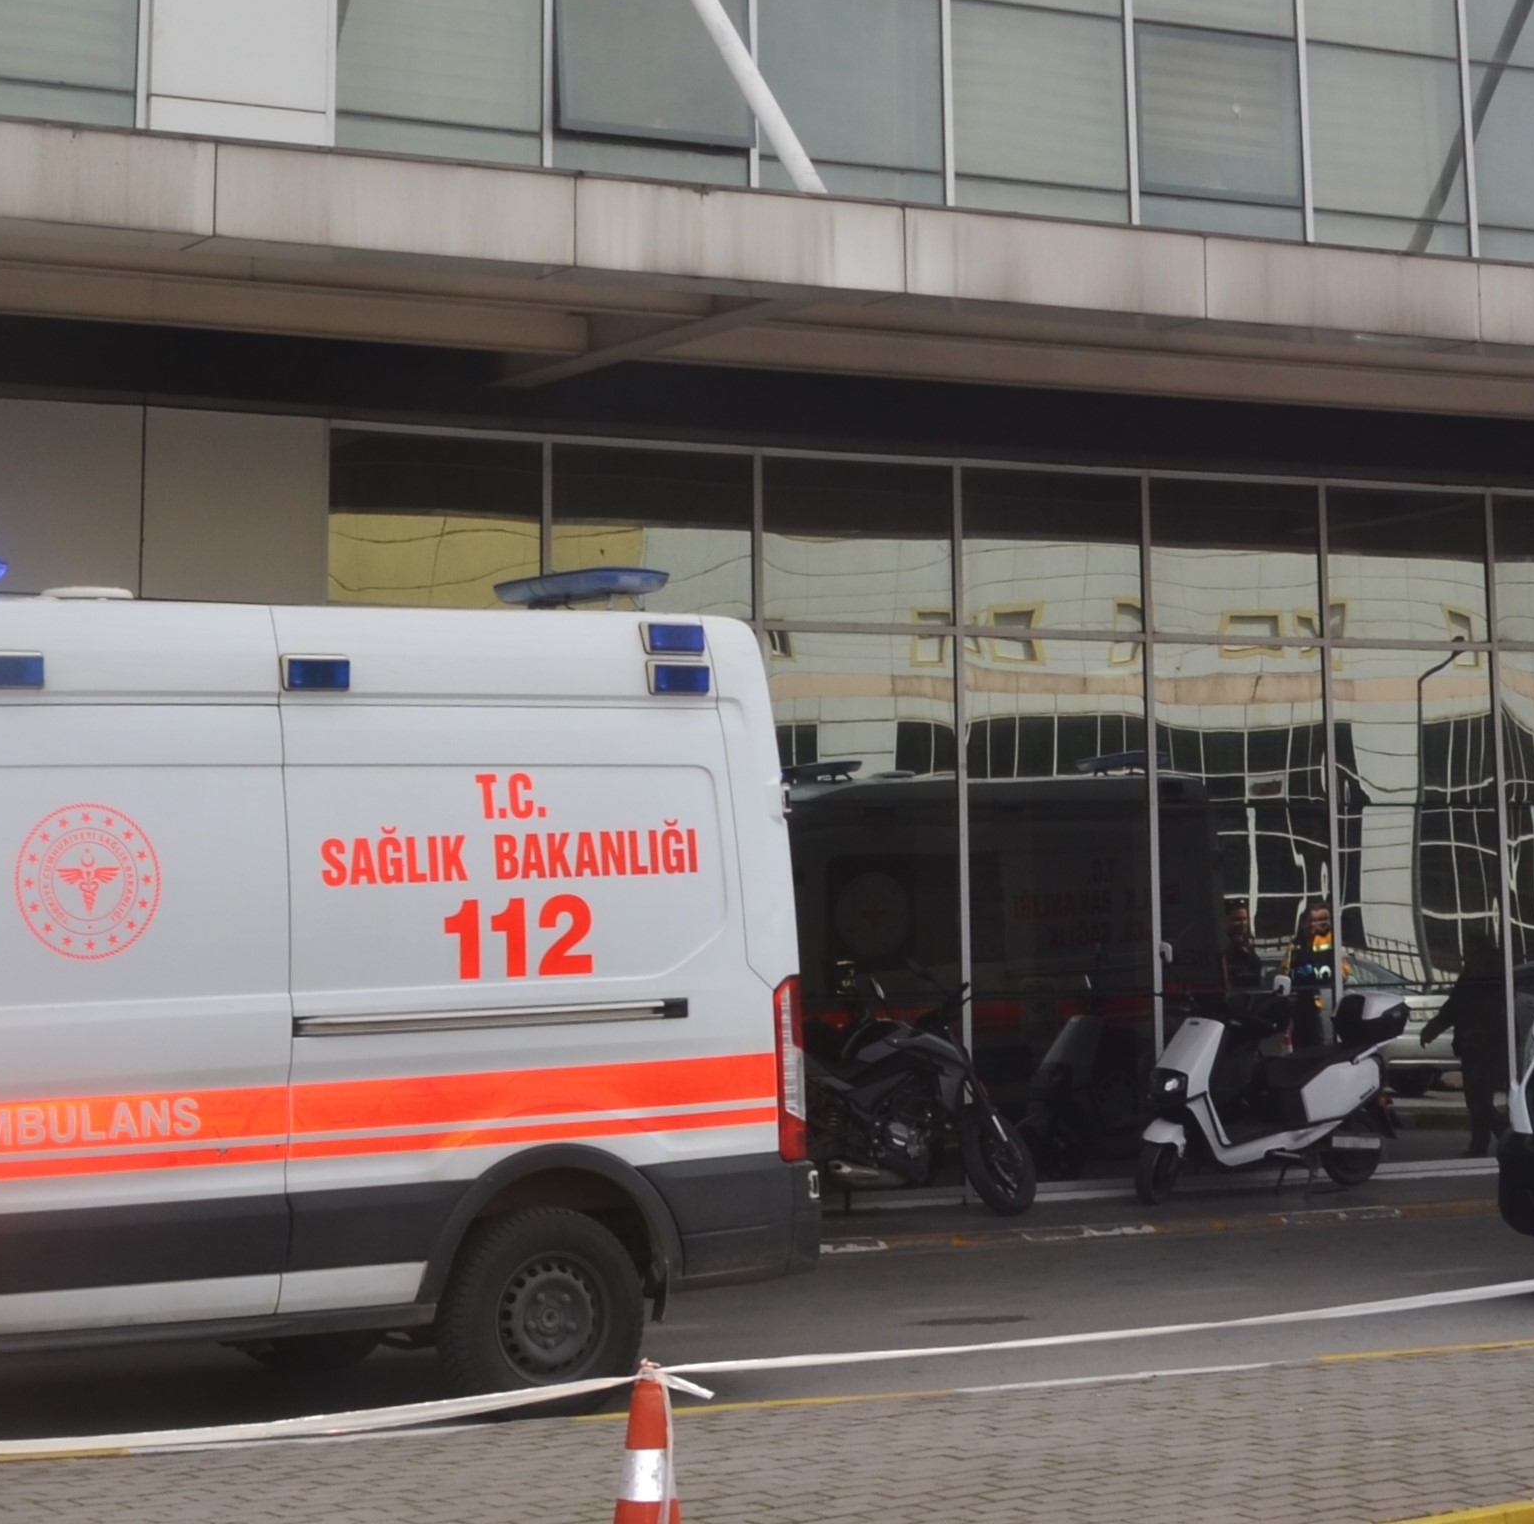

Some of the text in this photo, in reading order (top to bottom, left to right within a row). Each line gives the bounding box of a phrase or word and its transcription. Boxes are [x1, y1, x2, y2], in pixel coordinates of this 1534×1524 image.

[475, 772, 547, 820] T.C.
[320, 819, 699, 887] SAĞLIK BAKANLIĞI
[444, 893, 594, 980] 112
